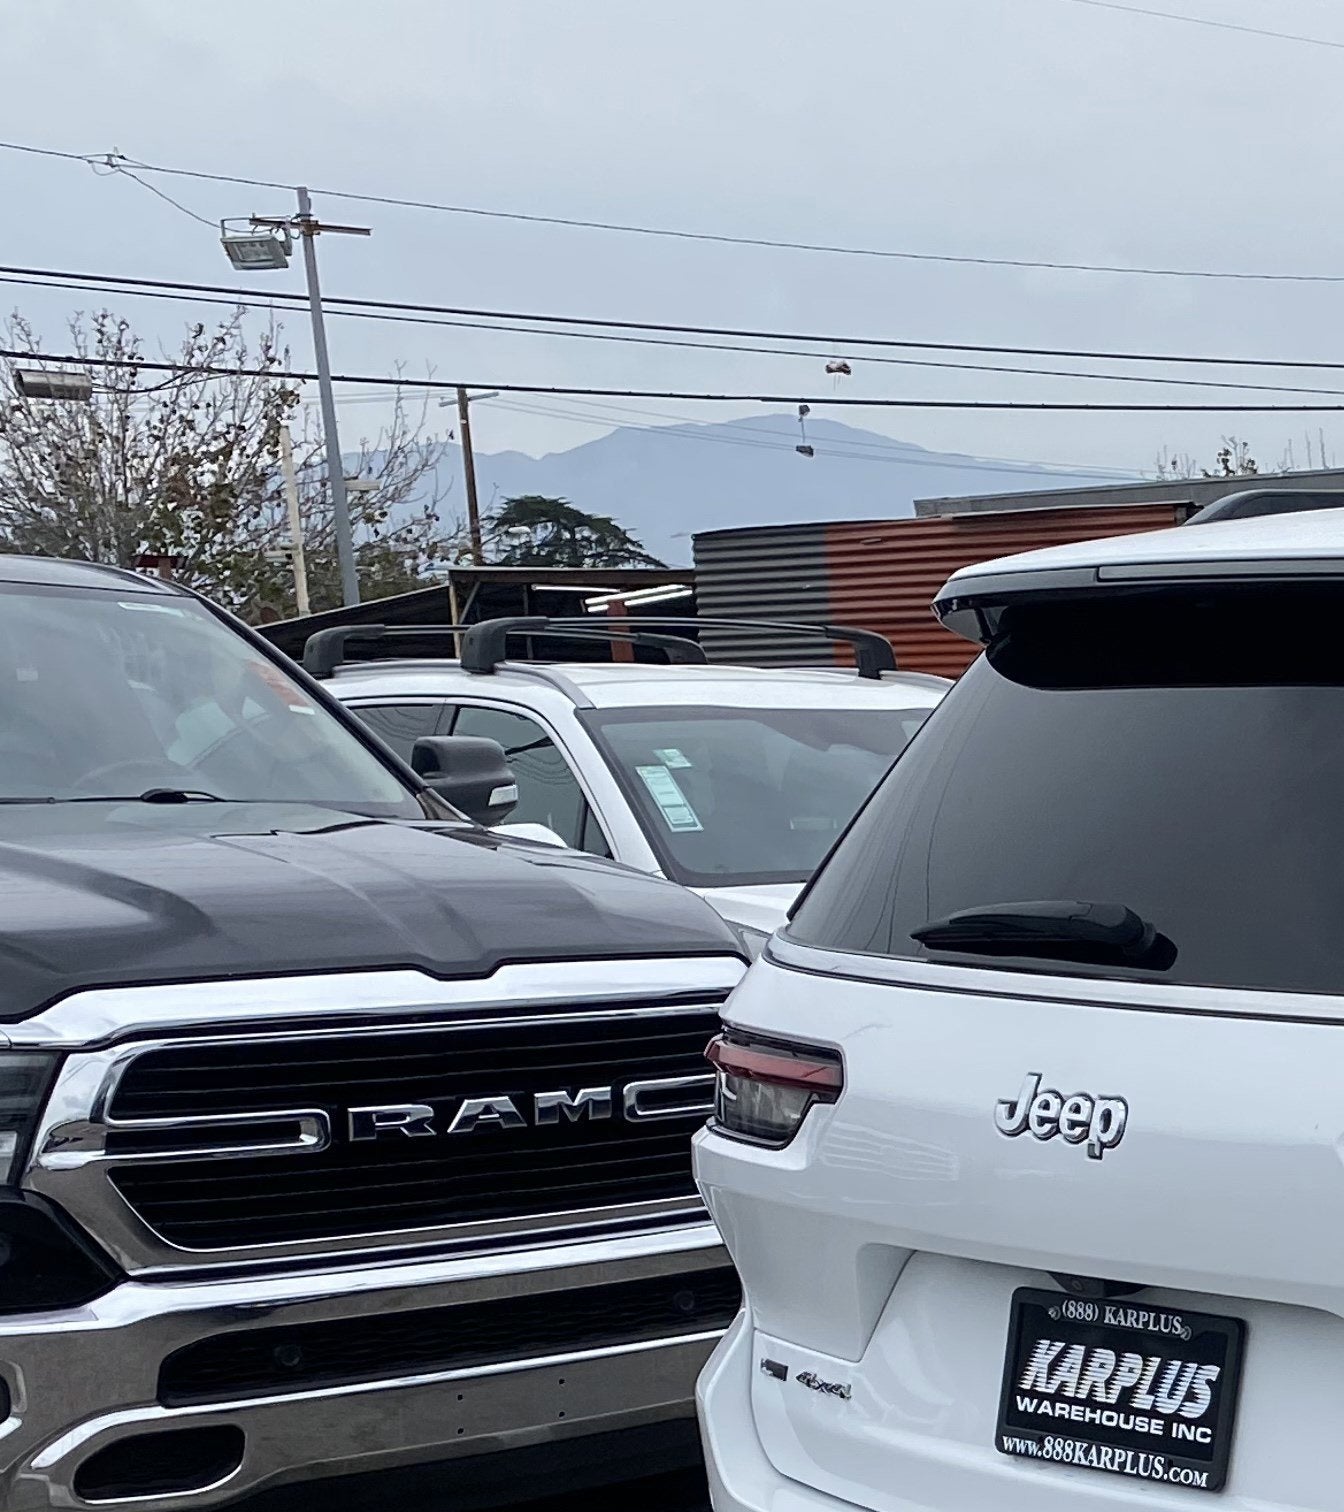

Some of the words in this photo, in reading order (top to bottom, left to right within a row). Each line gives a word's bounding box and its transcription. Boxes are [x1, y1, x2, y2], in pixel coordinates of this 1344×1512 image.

[348, 1086, 613, 1142] RAM
[996, 1072, 1128, 1160] Jeep
[1061, 1299, 1099, 1322] (888)
[1103, 1305, 1183, 1335] KARPLUS
[1017, 1338, 1221, 1419] KARPLUS
[1015, 1395, 1164, 1435] WAREHOUSE
[1171, 1422, 1213, 1444] INC
